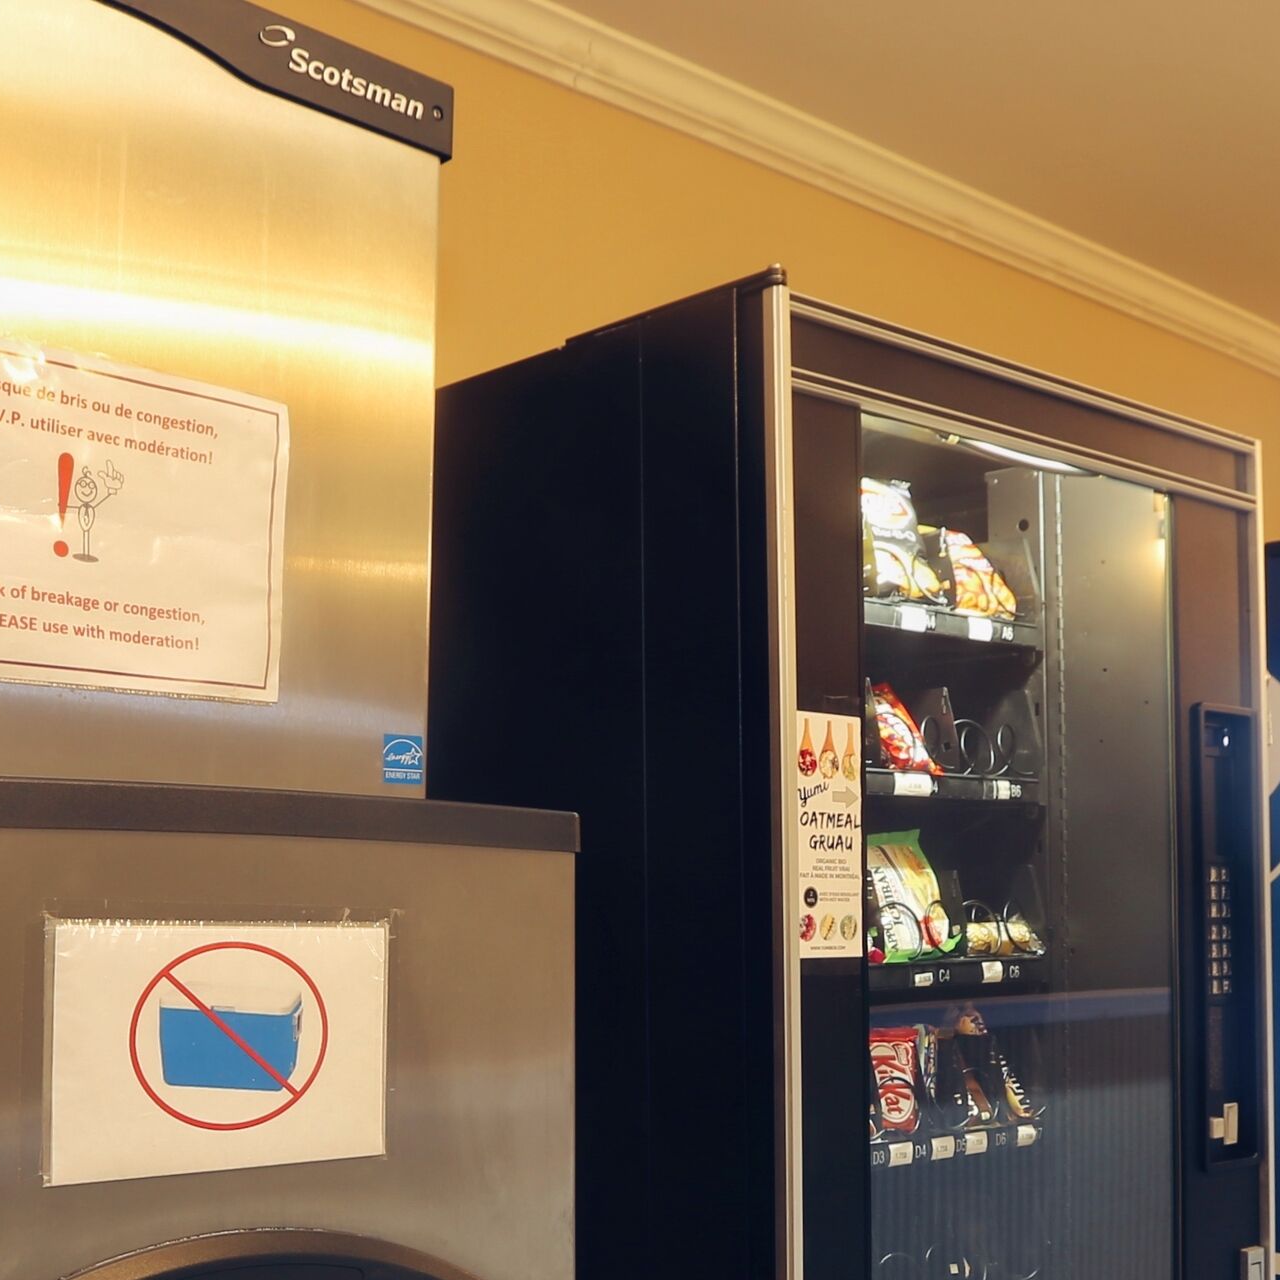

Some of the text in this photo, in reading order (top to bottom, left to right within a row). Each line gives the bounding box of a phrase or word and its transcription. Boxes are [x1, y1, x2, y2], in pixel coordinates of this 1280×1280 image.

[288, 48, 424, 120] Scotsman
[36, 386, 55, 402] de
[60, 390, 87, 409] bris
[91, 400, 110, 414] ou
[114, 403, 132, 419] de
[136, 411, 218, 440] congestion,
[30, 418, 83, 438] utiliser
[86, 429, 120, 446] avec
[124, 437, 213, 465] modération!
[10, 585, 27, 600] of
[31, 586, 100, 612] breakage
[103, 600, 119, 612] or
[123, 603, 205, 626] congestion,
[42, 622, 68, 635] use
[73, 624, 105, 640] with
[109, 630, 199, 651] moderation!
[797, 781, 830, 808] Yumi
[800, 811, 861, 831] OATMEAL
[809, 834, 853, 852] GRUAU
[939, 969, 950, 982] C4
[1008, 965, 1020, 978] C6
[873, 1151, 885, 1165] D3
[915, 1144, 927, 1158] D4
[996, 1133, 1007, 1146] D6
